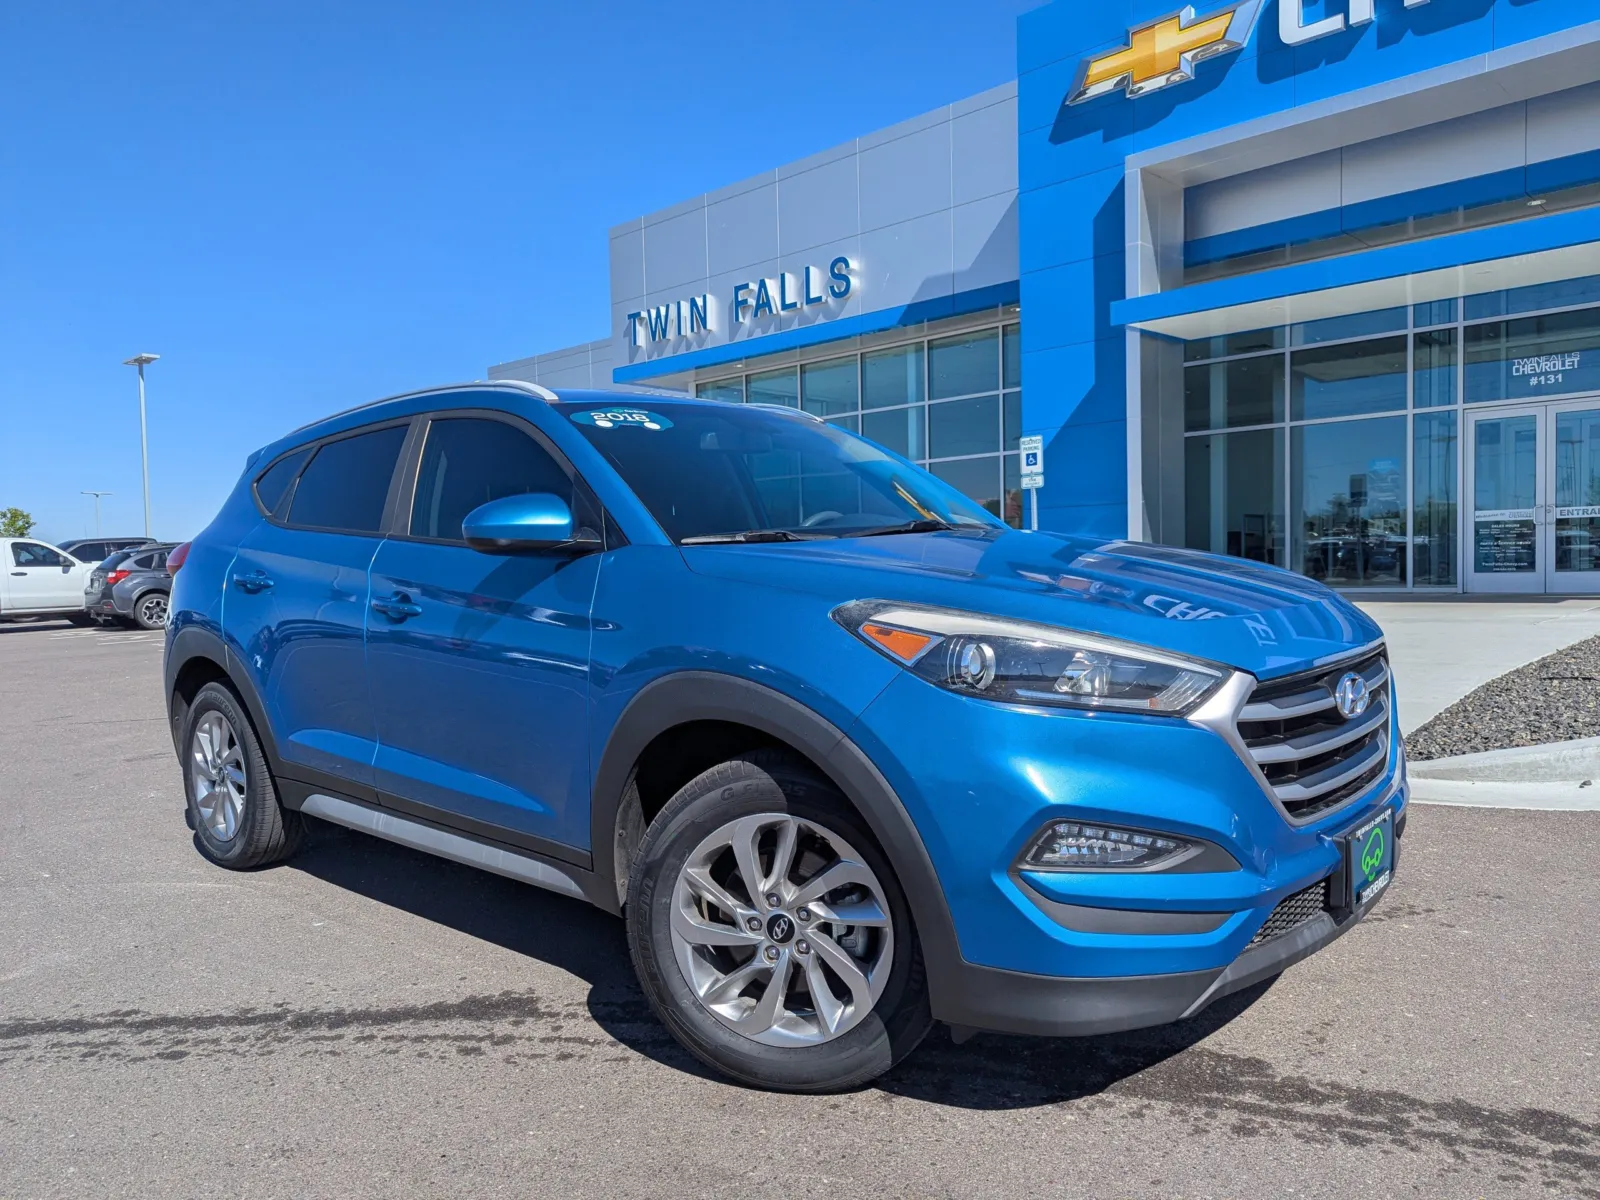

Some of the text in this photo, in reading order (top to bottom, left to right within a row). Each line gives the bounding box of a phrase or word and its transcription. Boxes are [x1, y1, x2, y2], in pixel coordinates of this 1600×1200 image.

[627, 256, 852, 346] TWIN FALLS
[1513, 359, 1579, 376] CHEVROLET
[1529, 373, 1563, 386] #131
[590, 412, 650, 422] 2018
[1559, 508, 1600, 517] ENTRA
